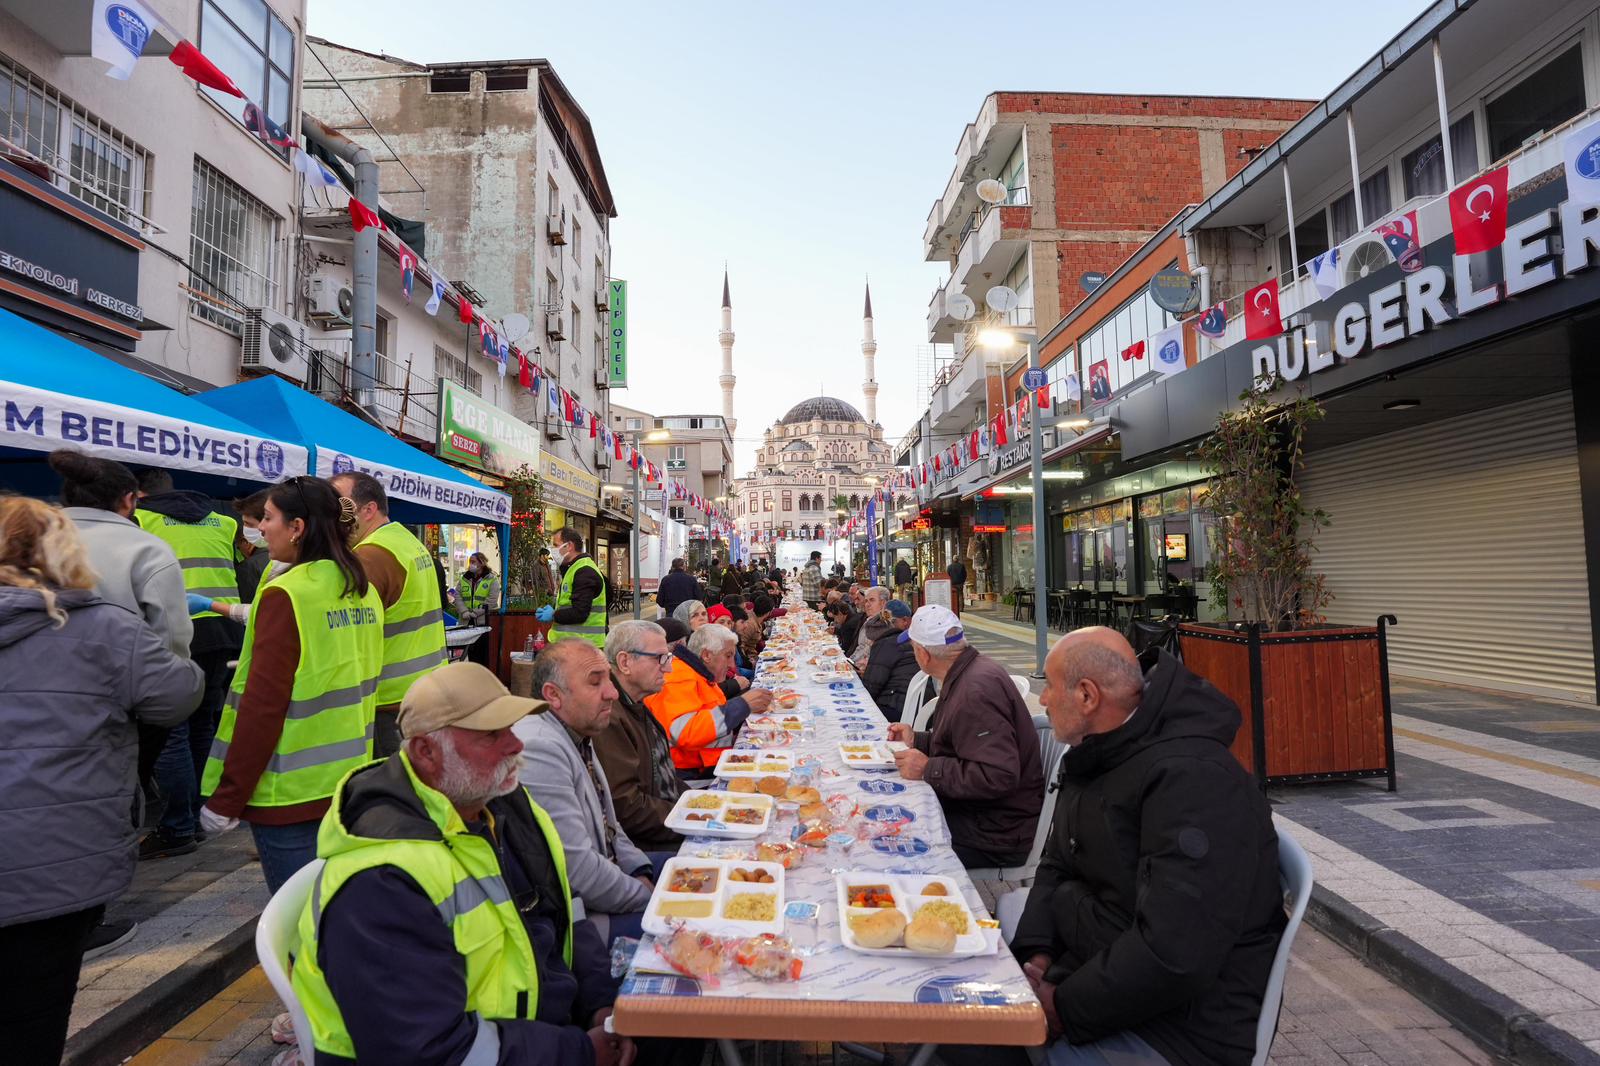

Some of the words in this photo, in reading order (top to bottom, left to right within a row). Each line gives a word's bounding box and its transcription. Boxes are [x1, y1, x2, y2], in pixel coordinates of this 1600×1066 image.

[87, 287, 144, 321] MERKEZİ
[613, 284, 622, 319] VIP
[613, 328, 623, 376] OTEL
[61, 411, 250, 468] BELEDİYESİ
[452, 396, 488, 435] EGE
[492, 416, 537, 456] MANAV
[453, 434, 479, 454] SEBZE
[1001, 440, 1031, 471] RESTAUR
[390, 472, 432, 500] DİDİM
[434, 486, 495, 513] BELEDİYESİ
